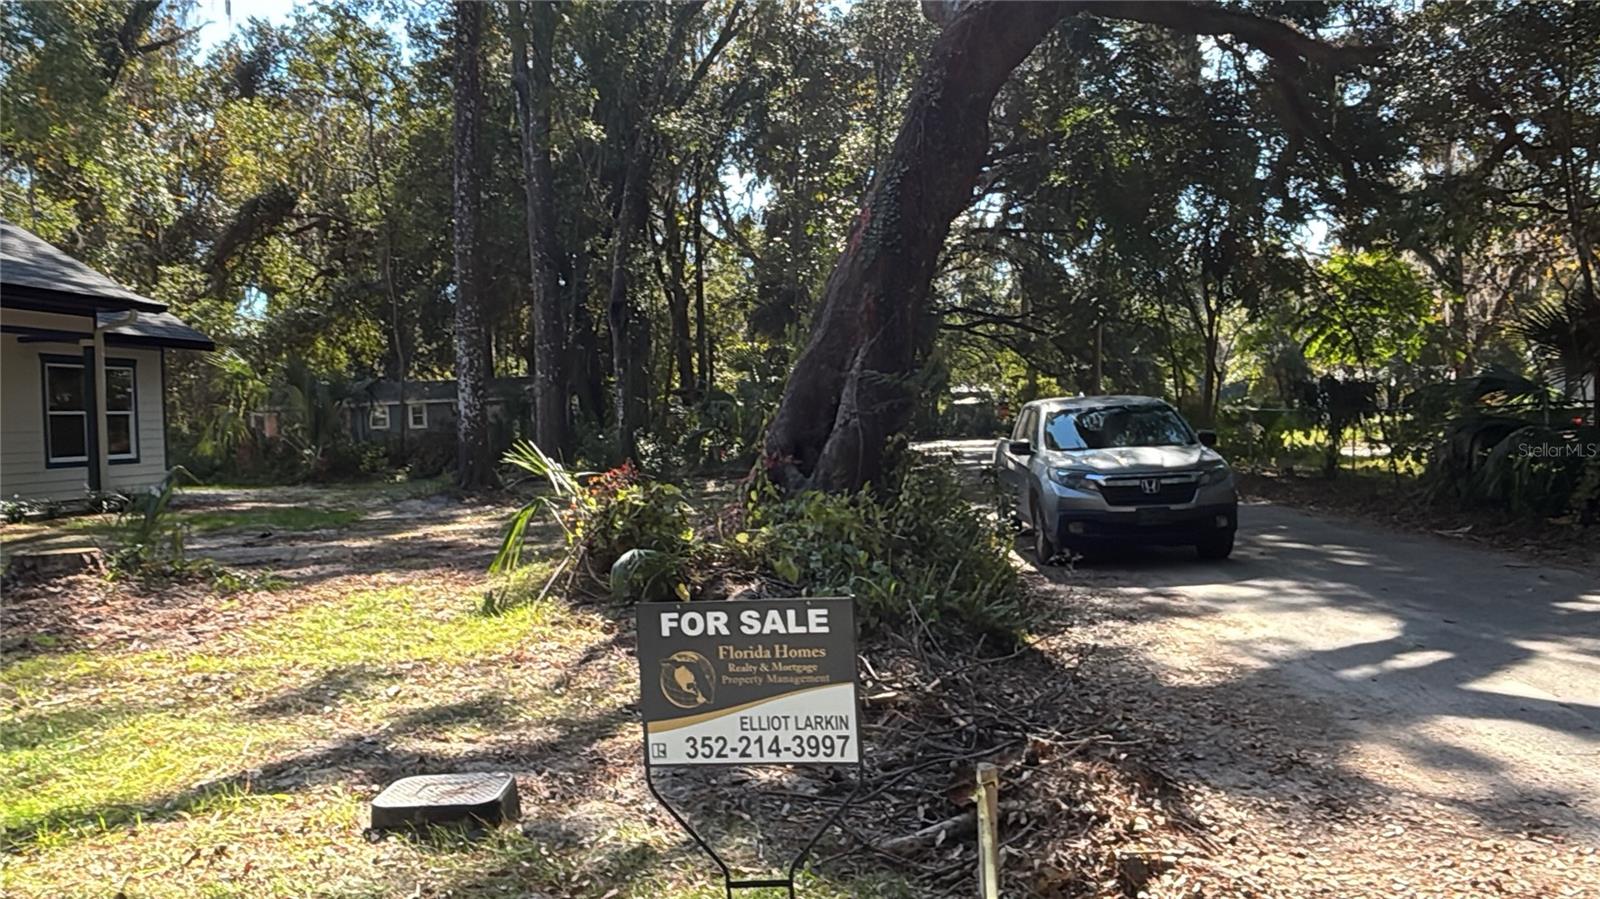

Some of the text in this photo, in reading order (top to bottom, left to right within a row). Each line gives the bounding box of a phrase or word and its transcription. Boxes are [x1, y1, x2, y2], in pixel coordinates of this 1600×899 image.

[660, 608, 830, 637] FOR SALE
[718, 644, 827, 660] Florida Homes
[728, 662, 818, 674] Realty & Mortgage
[721, 674, 831, 687] Property Management
[739, 715, 850, 731] ELLIOT LARKIN
[684, 735, 850, 759] 352-214-3997
